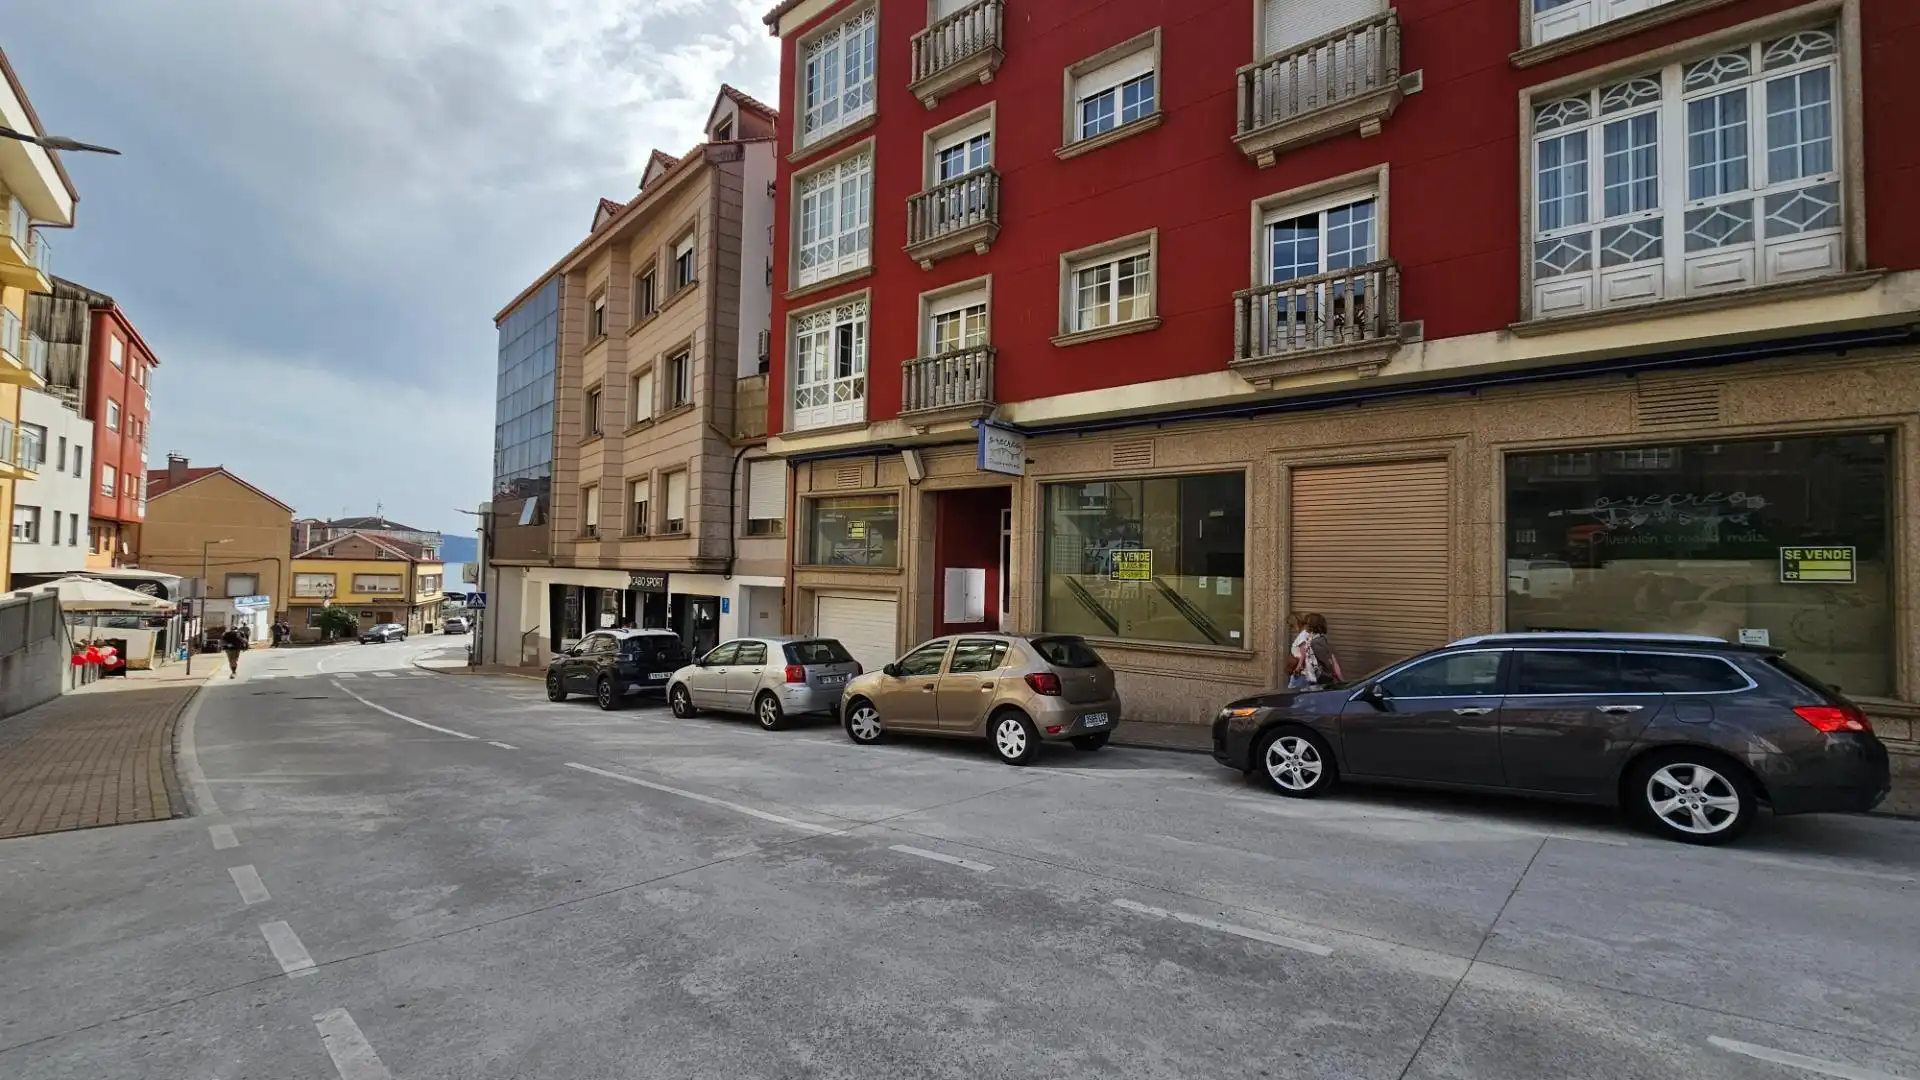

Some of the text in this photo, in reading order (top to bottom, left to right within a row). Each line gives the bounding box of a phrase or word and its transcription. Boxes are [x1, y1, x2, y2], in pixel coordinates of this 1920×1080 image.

[1112, 552, 1150, 561] SE VENDE
[1784, 549, 1852, 560] SE VENDE
[646, 577, 664, 588] SPORT
